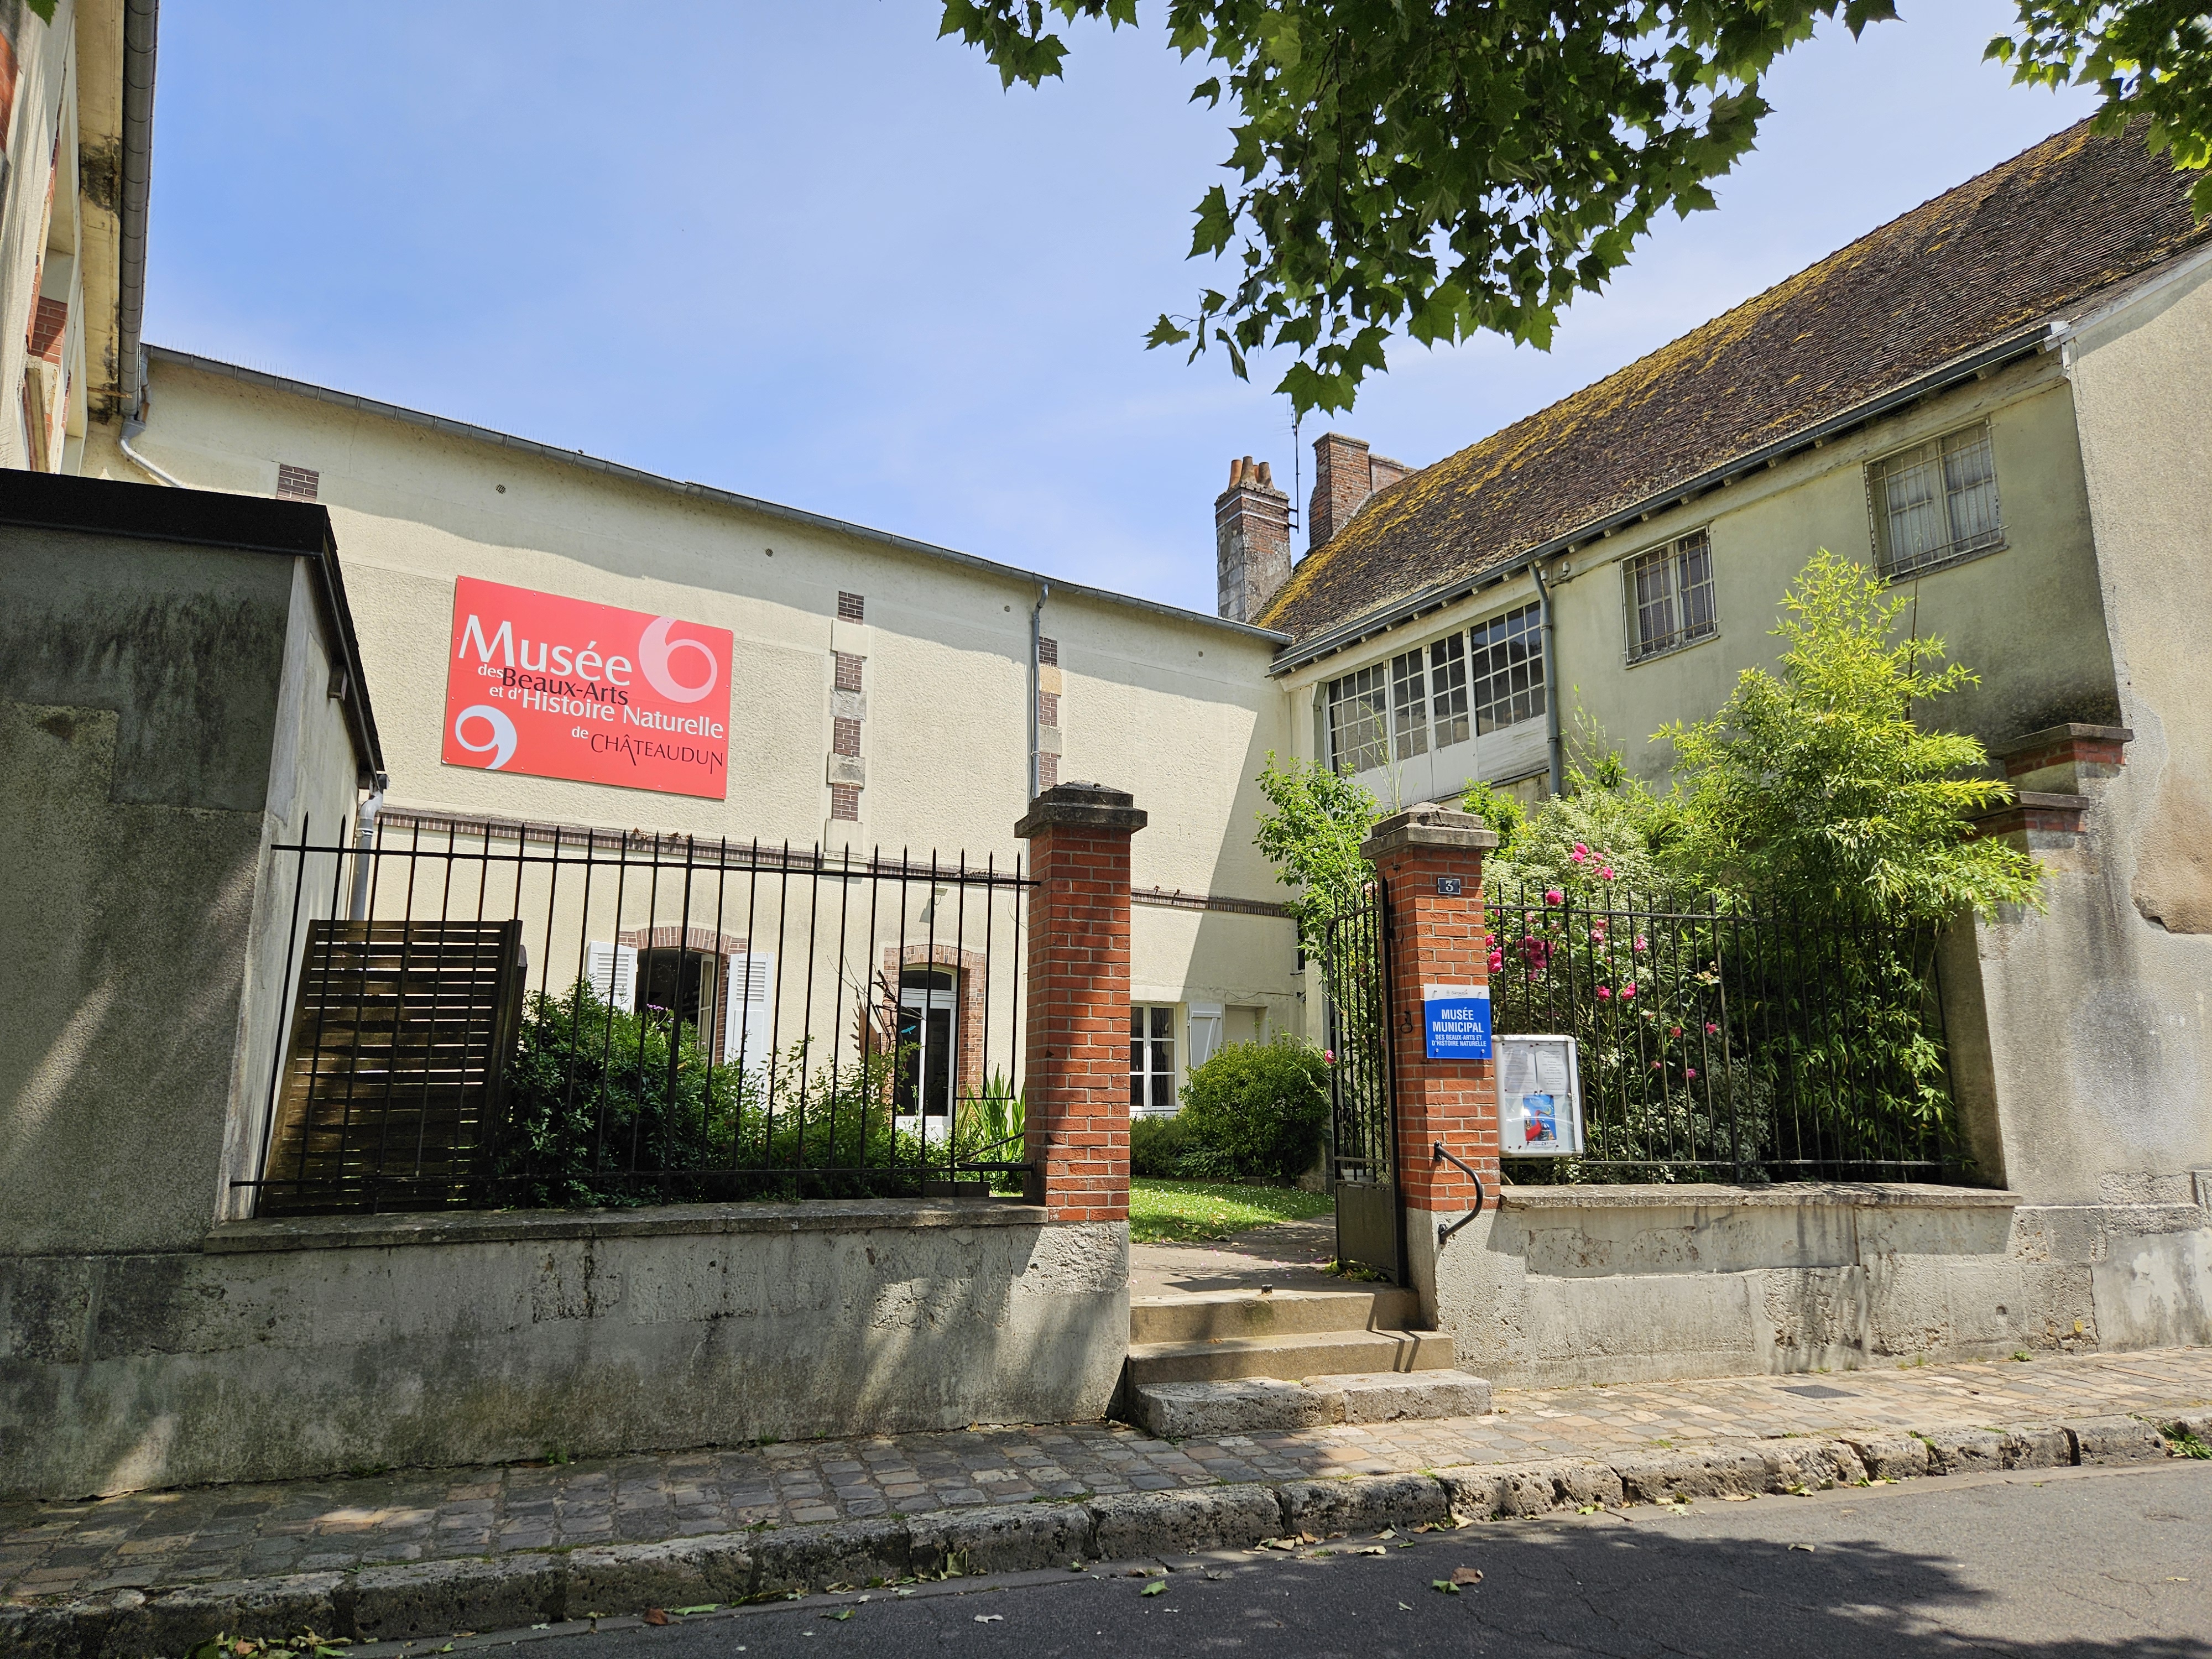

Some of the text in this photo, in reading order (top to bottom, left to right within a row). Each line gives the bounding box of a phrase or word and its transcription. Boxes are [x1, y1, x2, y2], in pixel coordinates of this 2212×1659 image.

[458, 614, 632, 686] Musée
[477, 664, 628, 706] des Beaux-Arts
[489, 686, 724, 739] et d'Histoire Naturelle
[571, 726, 723, 775] de CHÂTEAUDUN
[1445, 880, 1454, 892] 3
[1432, 1021, 1484, 1033] MUNICIPAL
[1441, 1006, 1474, 1020] MUSÉE
